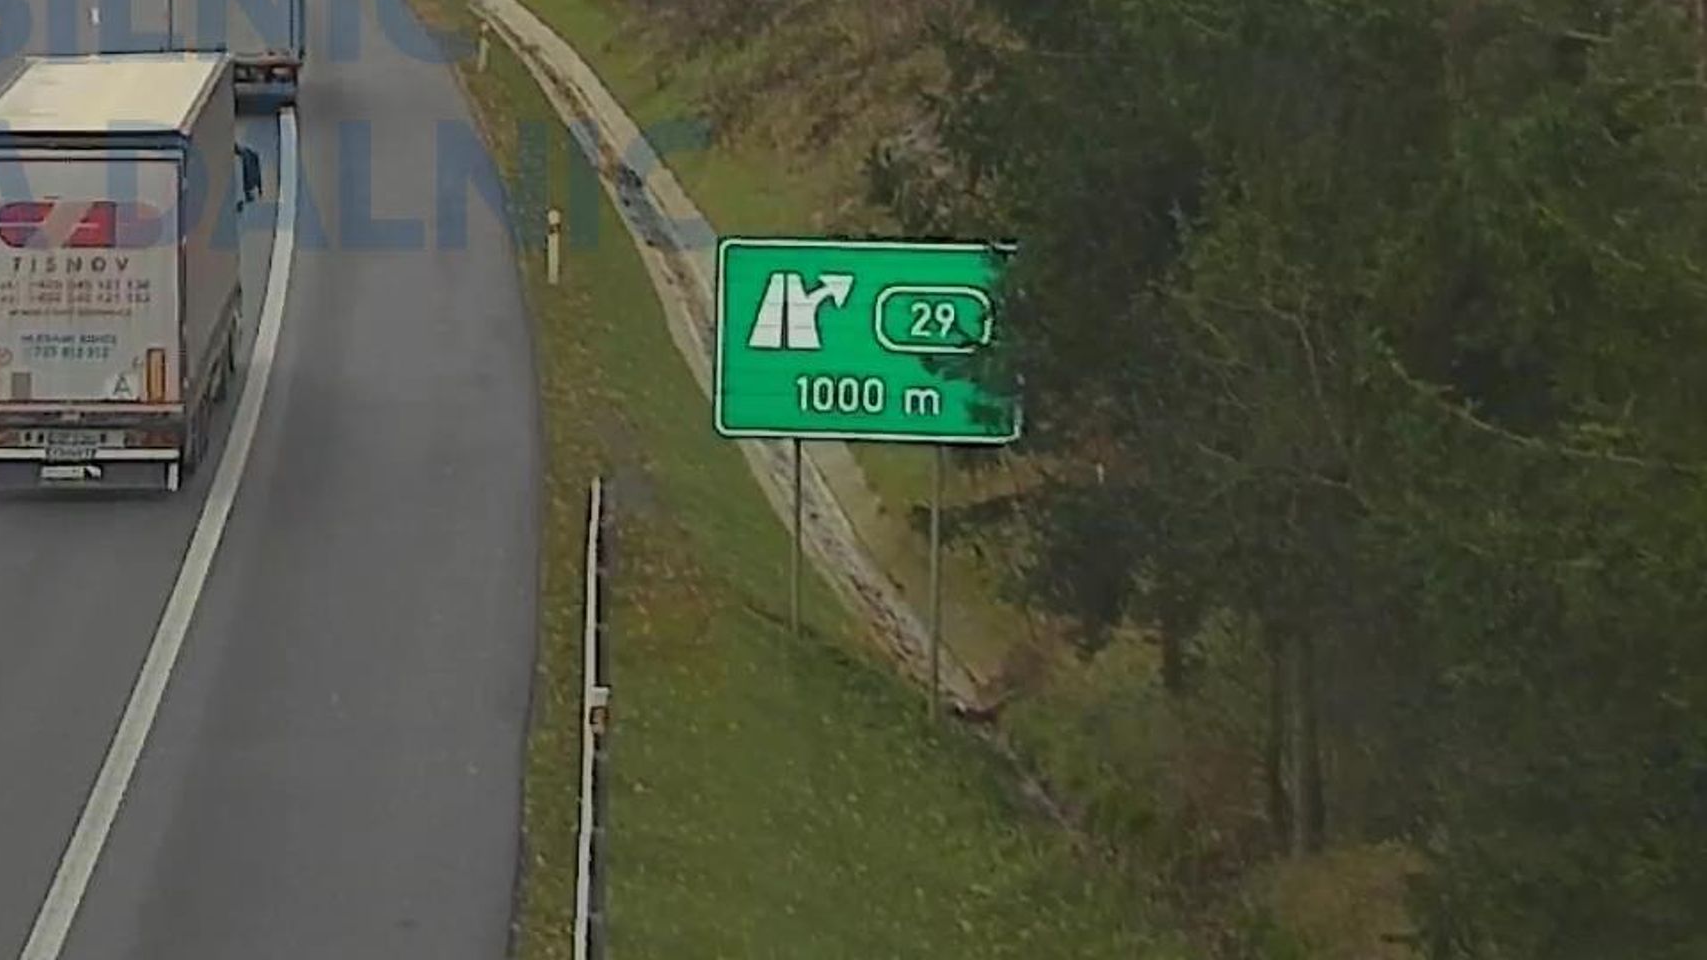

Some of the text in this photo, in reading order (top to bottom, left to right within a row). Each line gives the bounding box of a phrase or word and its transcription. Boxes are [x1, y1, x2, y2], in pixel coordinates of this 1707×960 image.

[910, 302, 956, 338] 29
[796, 376, 941, 416] 1000 m
